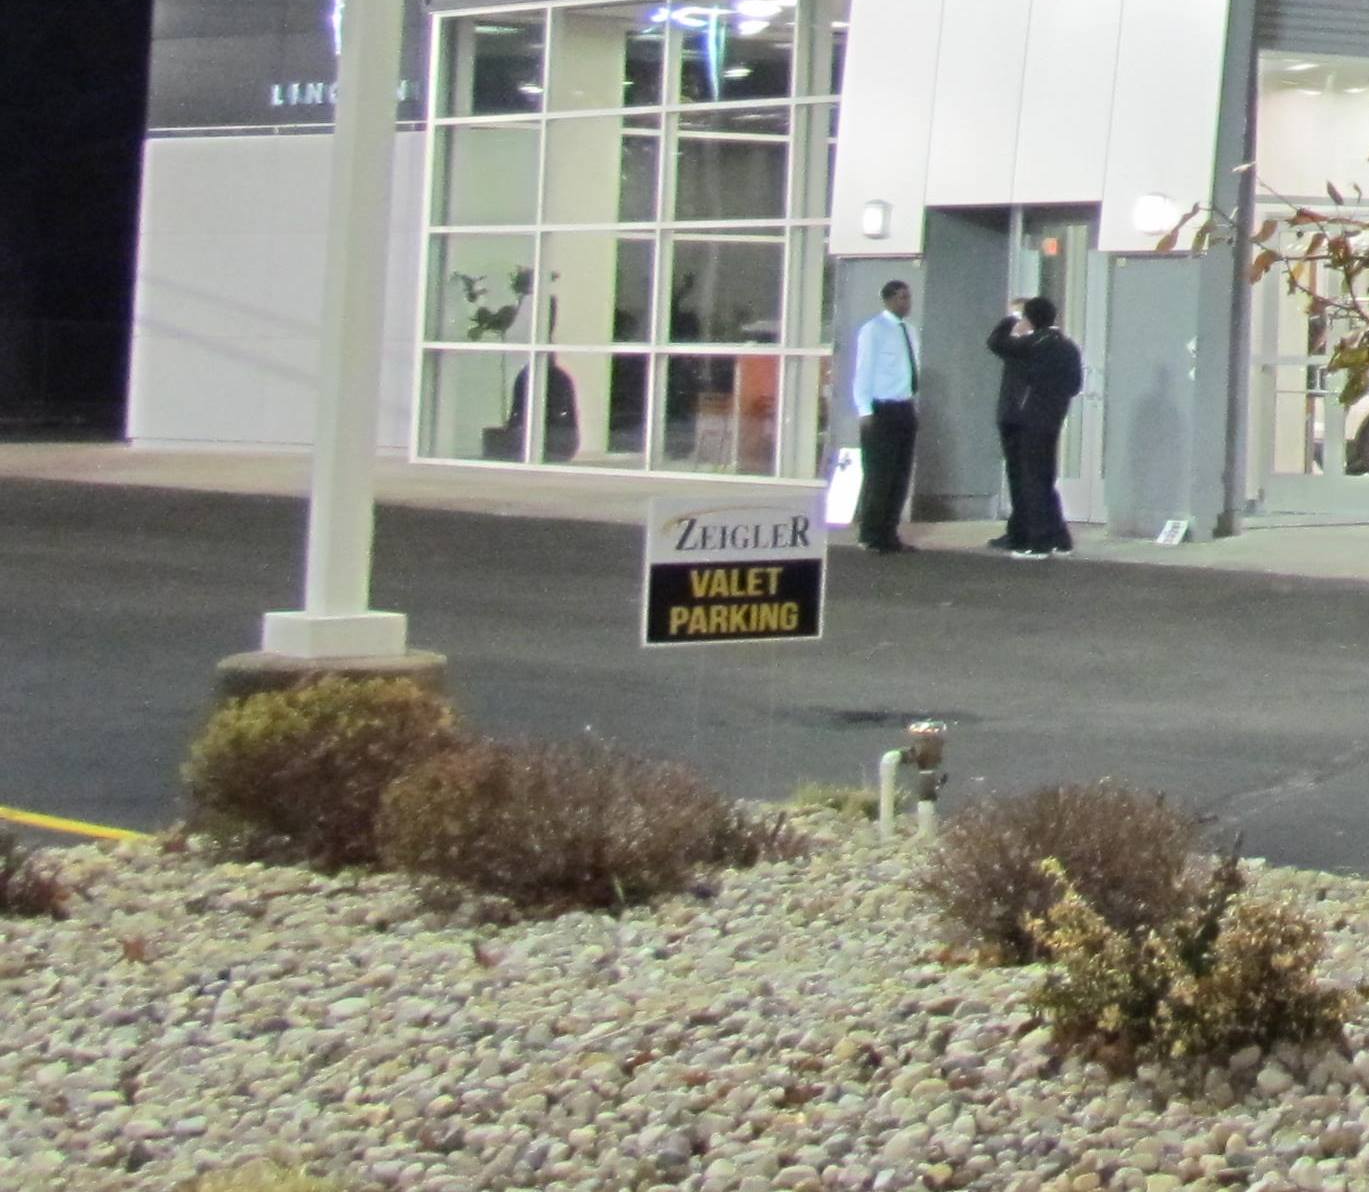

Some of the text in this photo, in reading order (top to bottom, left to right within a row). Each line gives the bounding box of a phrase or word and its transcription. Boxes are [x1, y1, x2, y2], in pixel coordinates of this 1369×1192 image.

[674, 514, 810, 551] ZEIGLER
[690, 567, 784, 598] VALET
[669, 602, 799, 636] PARKING
